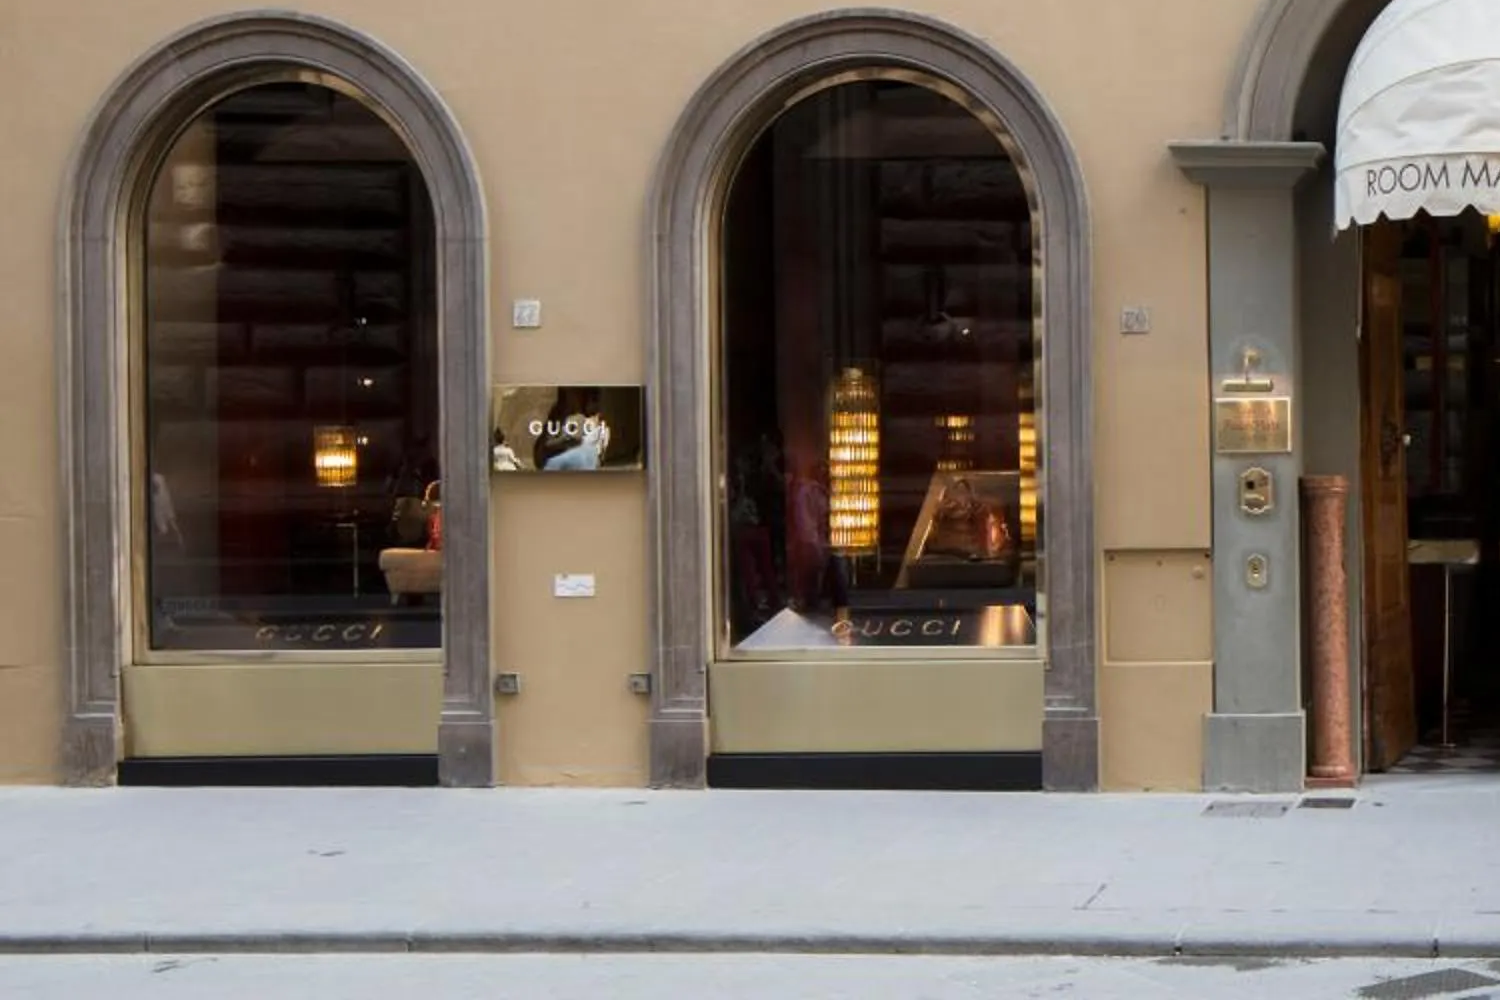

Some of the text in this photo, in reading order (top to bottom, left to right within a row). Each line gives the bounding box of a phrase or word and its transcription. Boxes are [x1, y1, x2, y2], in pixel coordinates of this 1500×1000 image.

[1366, 161, 1451, 197] ROOM
[529, 420, 606, 436] GUCCI
[831, 619, 961, 636] GUCCI
